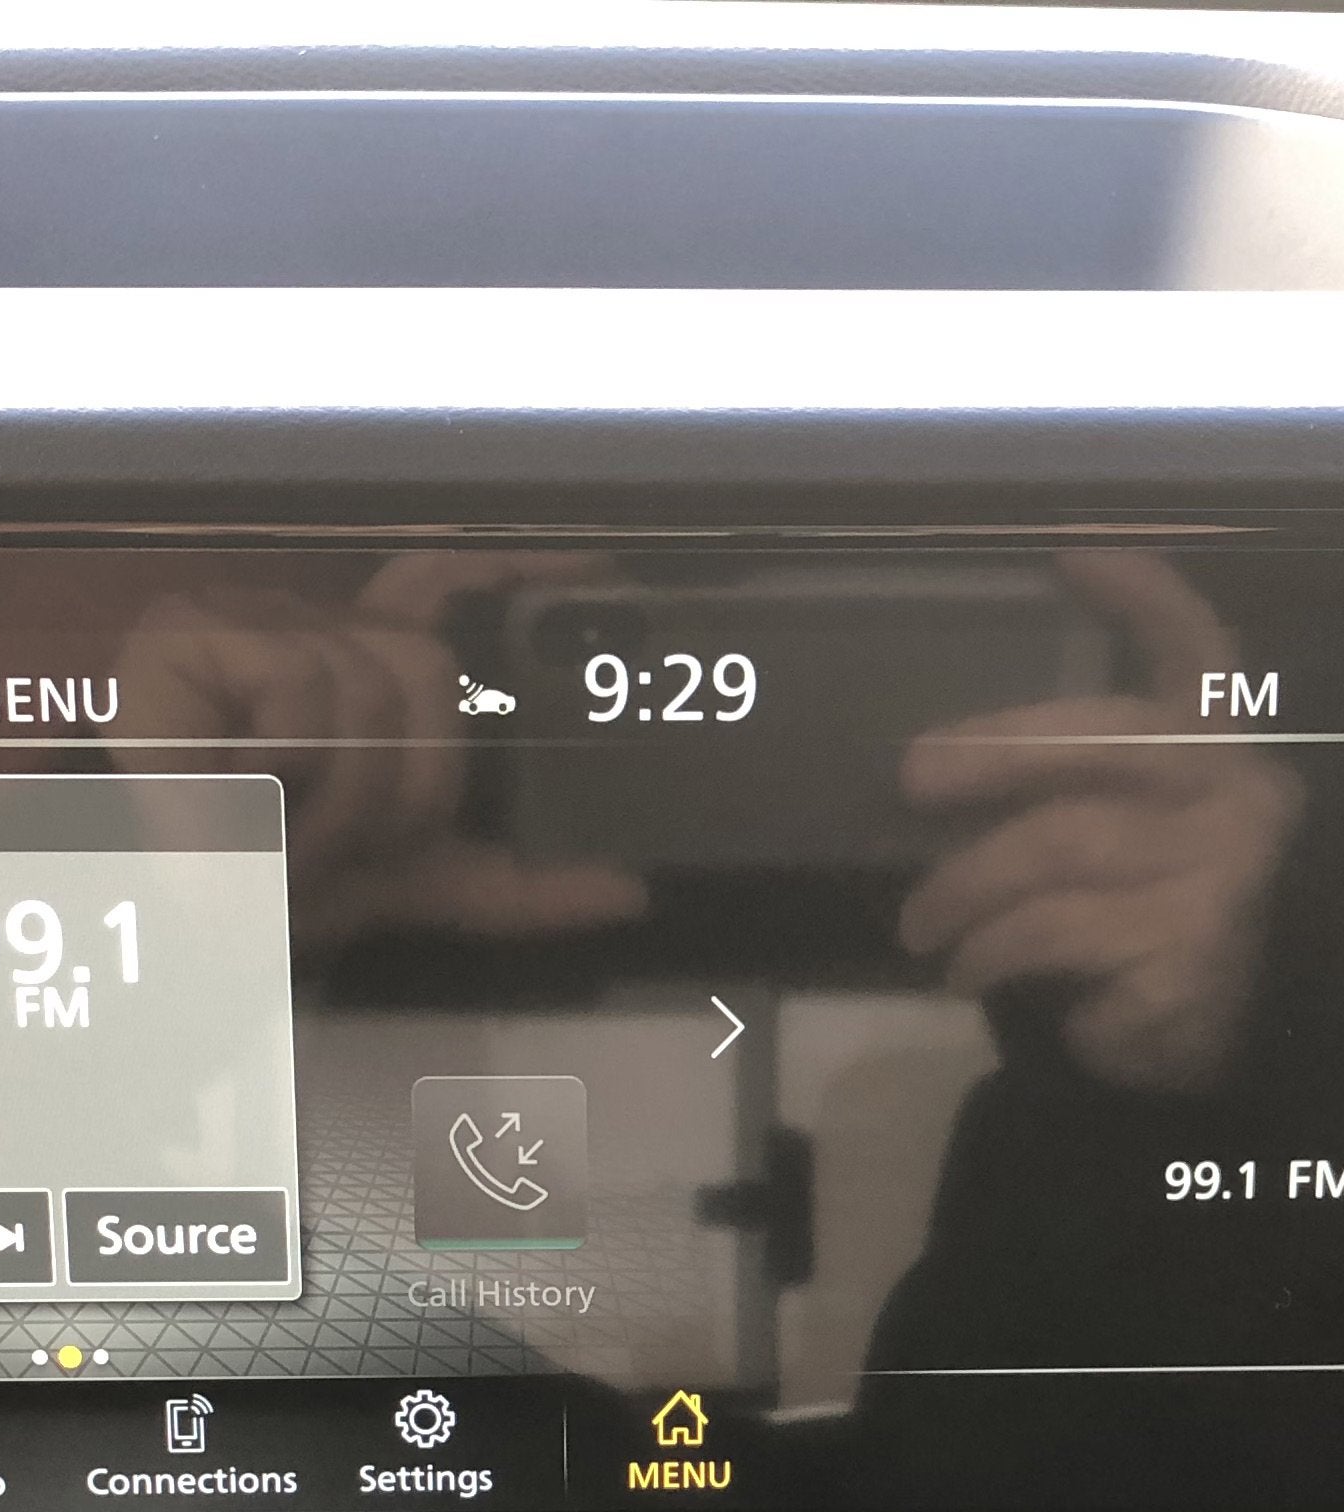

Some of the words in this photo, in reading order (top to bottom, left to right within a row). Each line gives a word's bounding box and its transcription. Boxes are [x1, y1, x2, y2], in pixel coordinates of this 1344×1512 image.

[583, 653, 758, 723] 9:29
[1199, 672, 1280, 717] FM
[14, 987, 90, 1028] FM
[1163, 1160, 1258, 1201] 99.1
[96, 1215, 258, 1256] Source
[407, 1281, 467, 1308] Call
[478, 1280, 596, 1313] History
[86, 1466, 298, 1496] Connections
[358, 1464, 493, 1498] Settings
[627, 1459, 733, 1490] MENU
